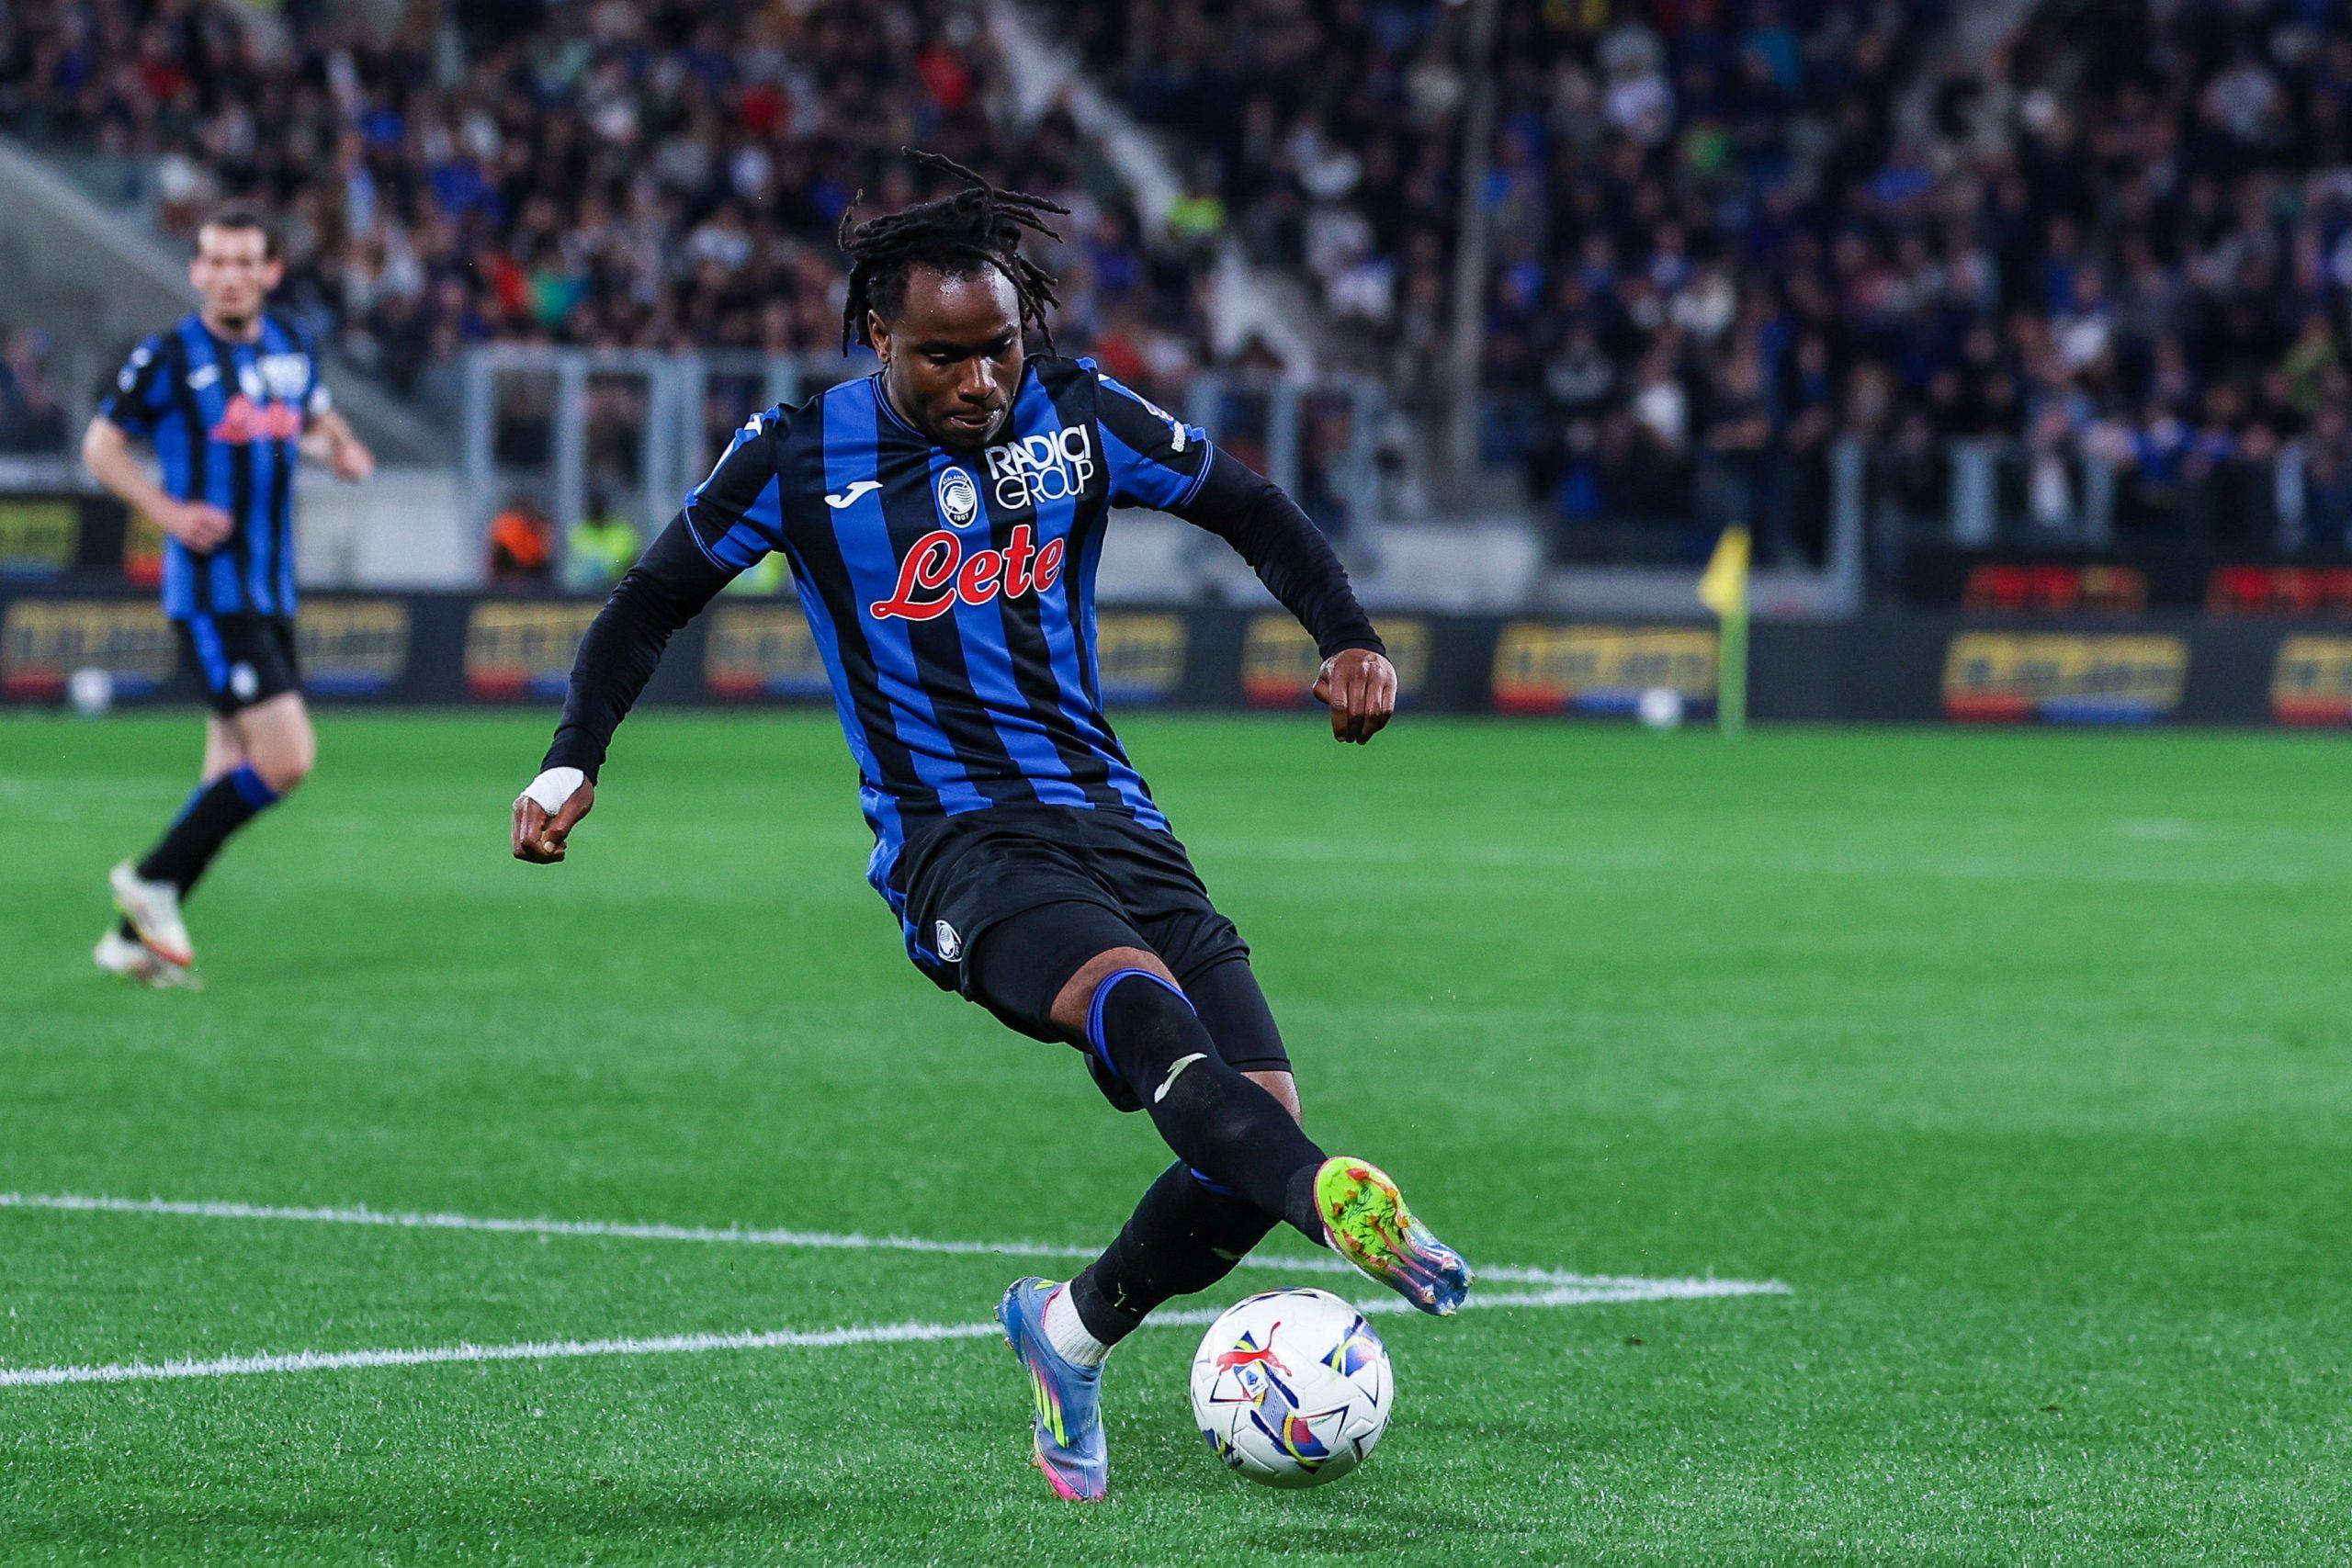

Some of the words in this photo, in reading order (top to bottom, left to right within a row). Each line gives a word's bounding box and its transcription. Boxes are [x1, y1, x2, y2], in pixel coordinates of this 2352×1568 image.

[985, 423, 1091, 480] RADICI
[995, 459, 1094, 510] GROUP
[870, 525, 1064, 621] Lete
